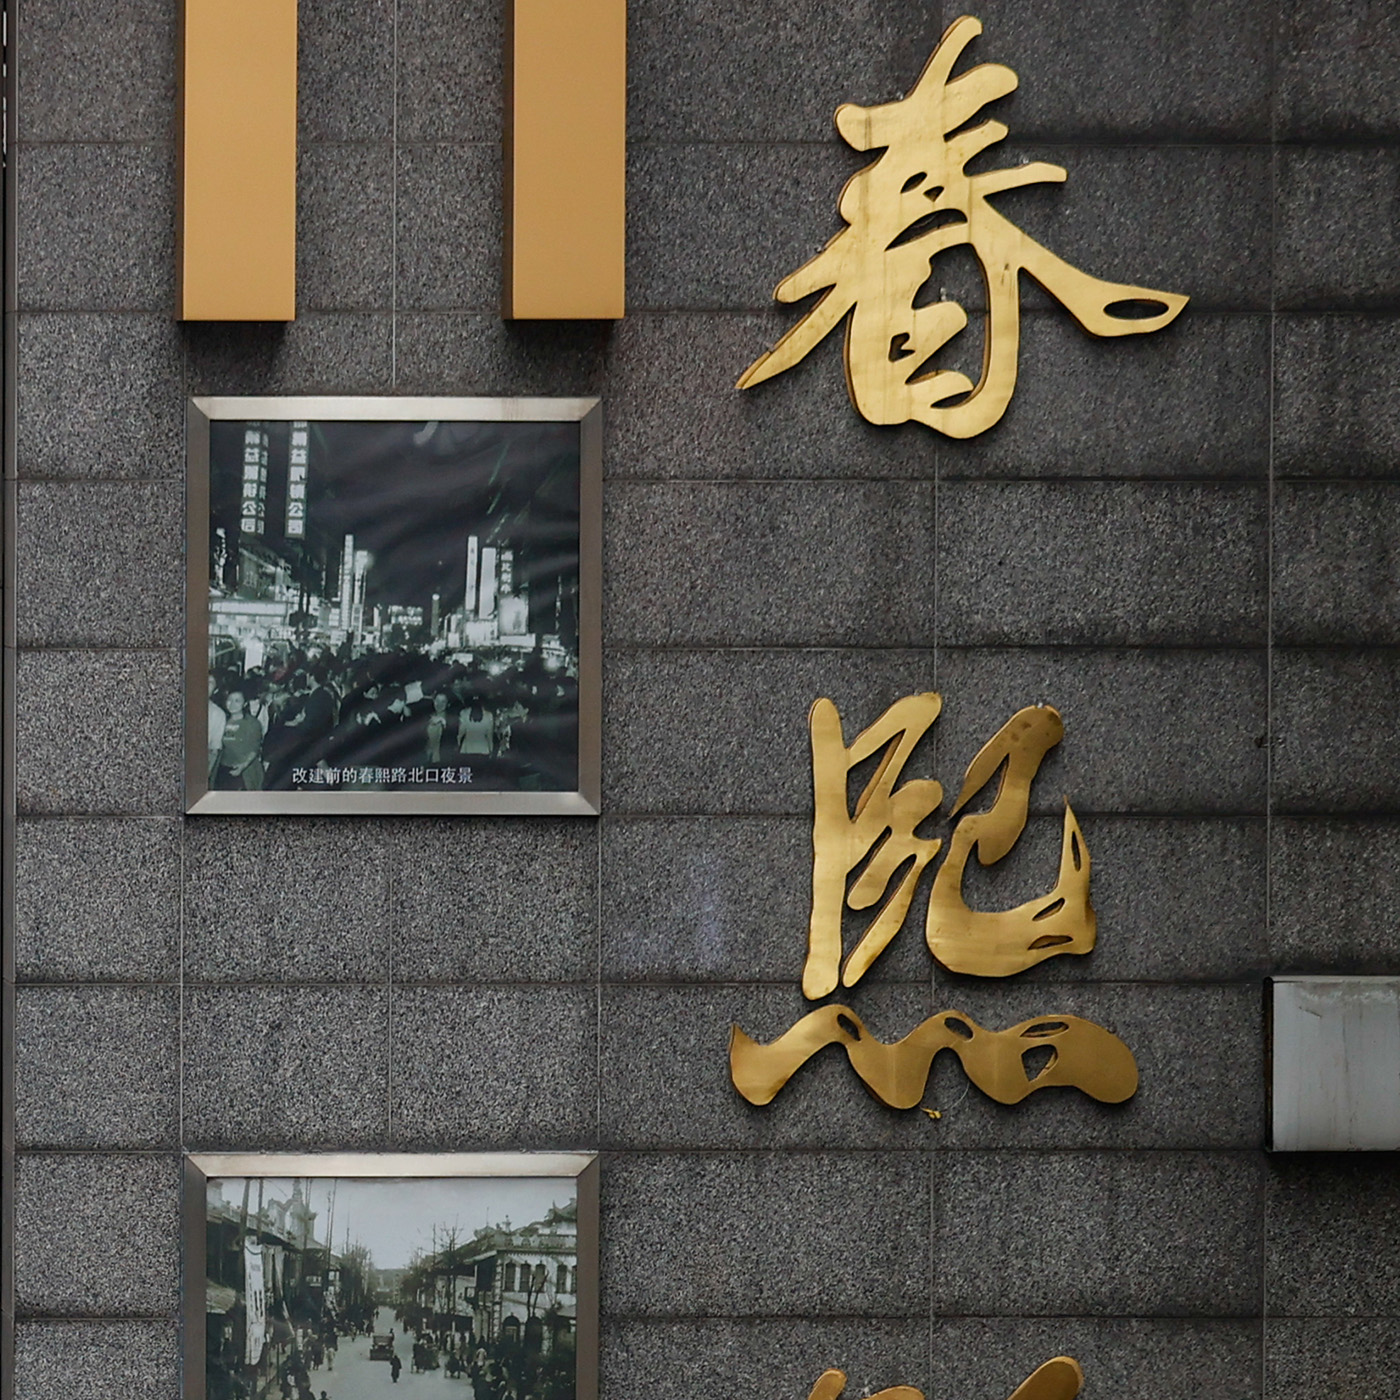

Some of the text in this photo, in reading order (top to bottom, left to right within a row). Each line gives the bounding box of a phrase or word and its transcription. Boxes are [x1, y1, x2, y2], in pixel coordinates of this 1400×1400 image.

[292, 767, 473, 786] 改建前的春熙路北口夜景
